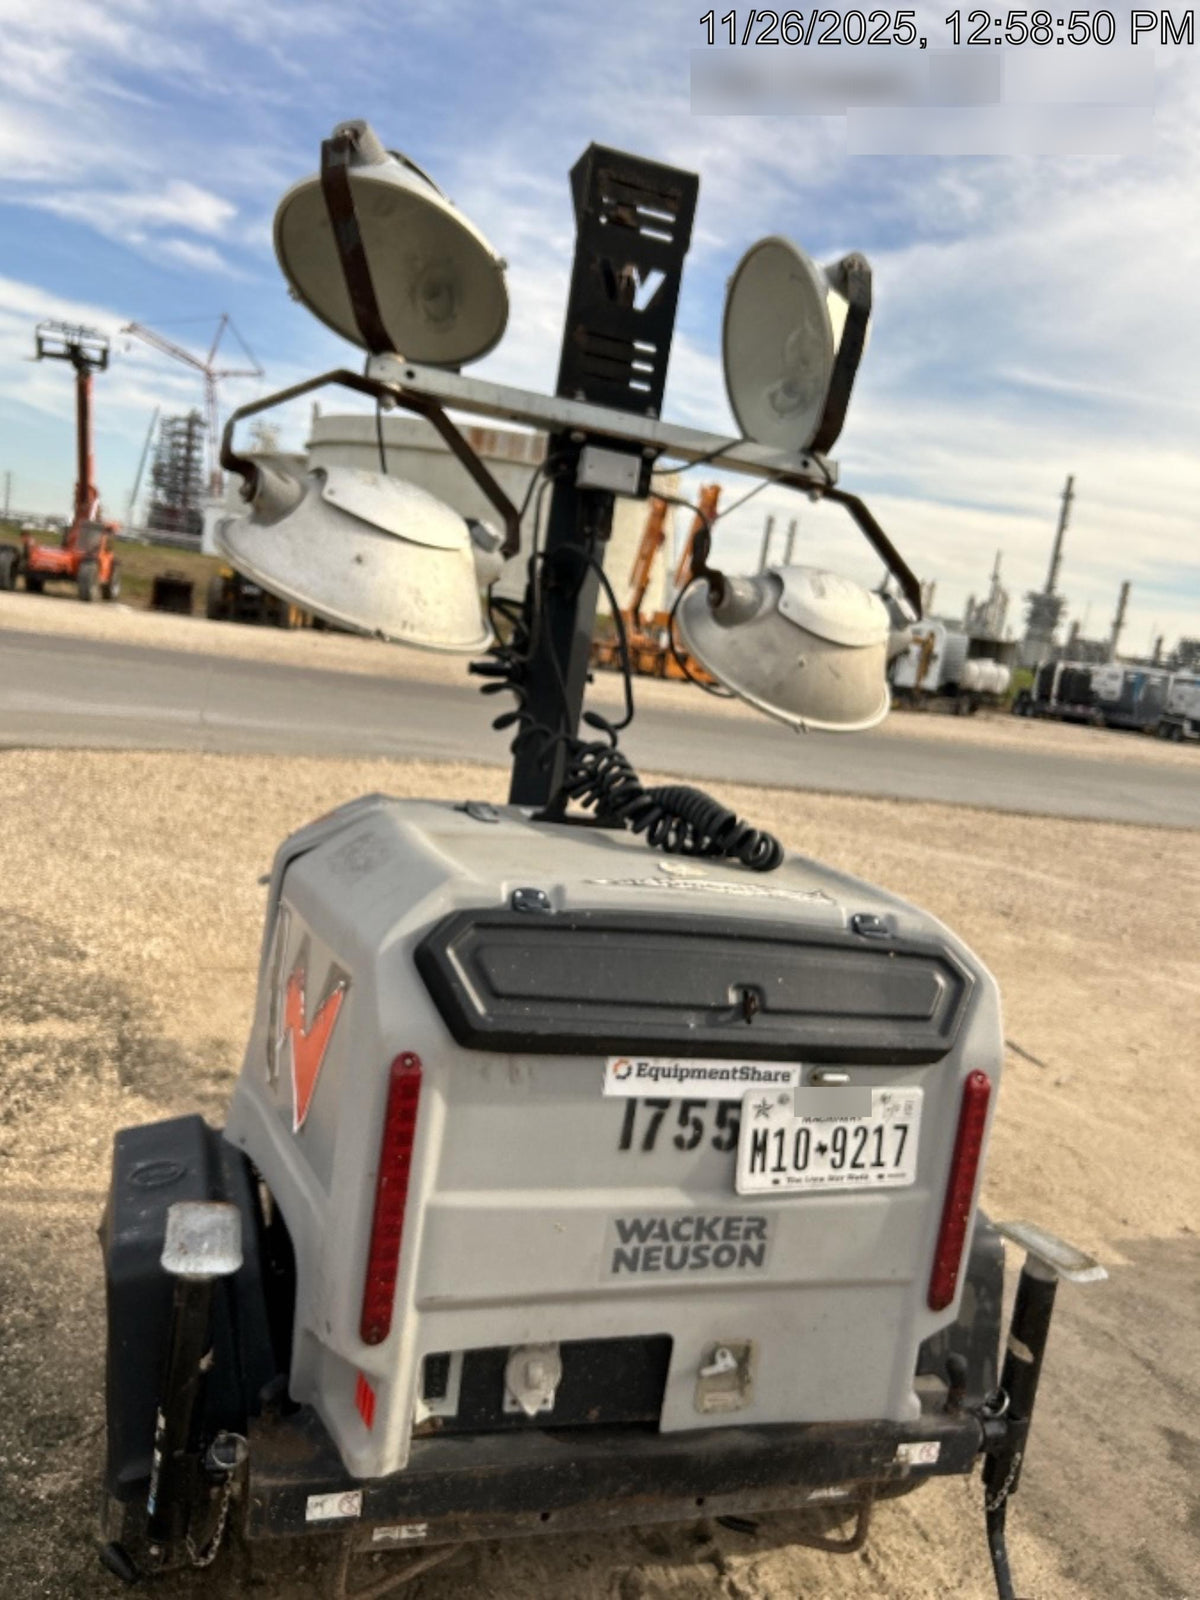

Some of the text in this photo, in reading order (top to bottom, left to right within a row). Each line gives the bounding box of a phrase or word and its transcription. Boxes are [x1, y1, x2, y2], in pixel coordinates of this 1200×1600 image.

[635, 1062, 791, 1082] EquipmentShare
[614, 1215, 768, 1245] WACKER
[611, 1244, 767, 1274] NEUSON
